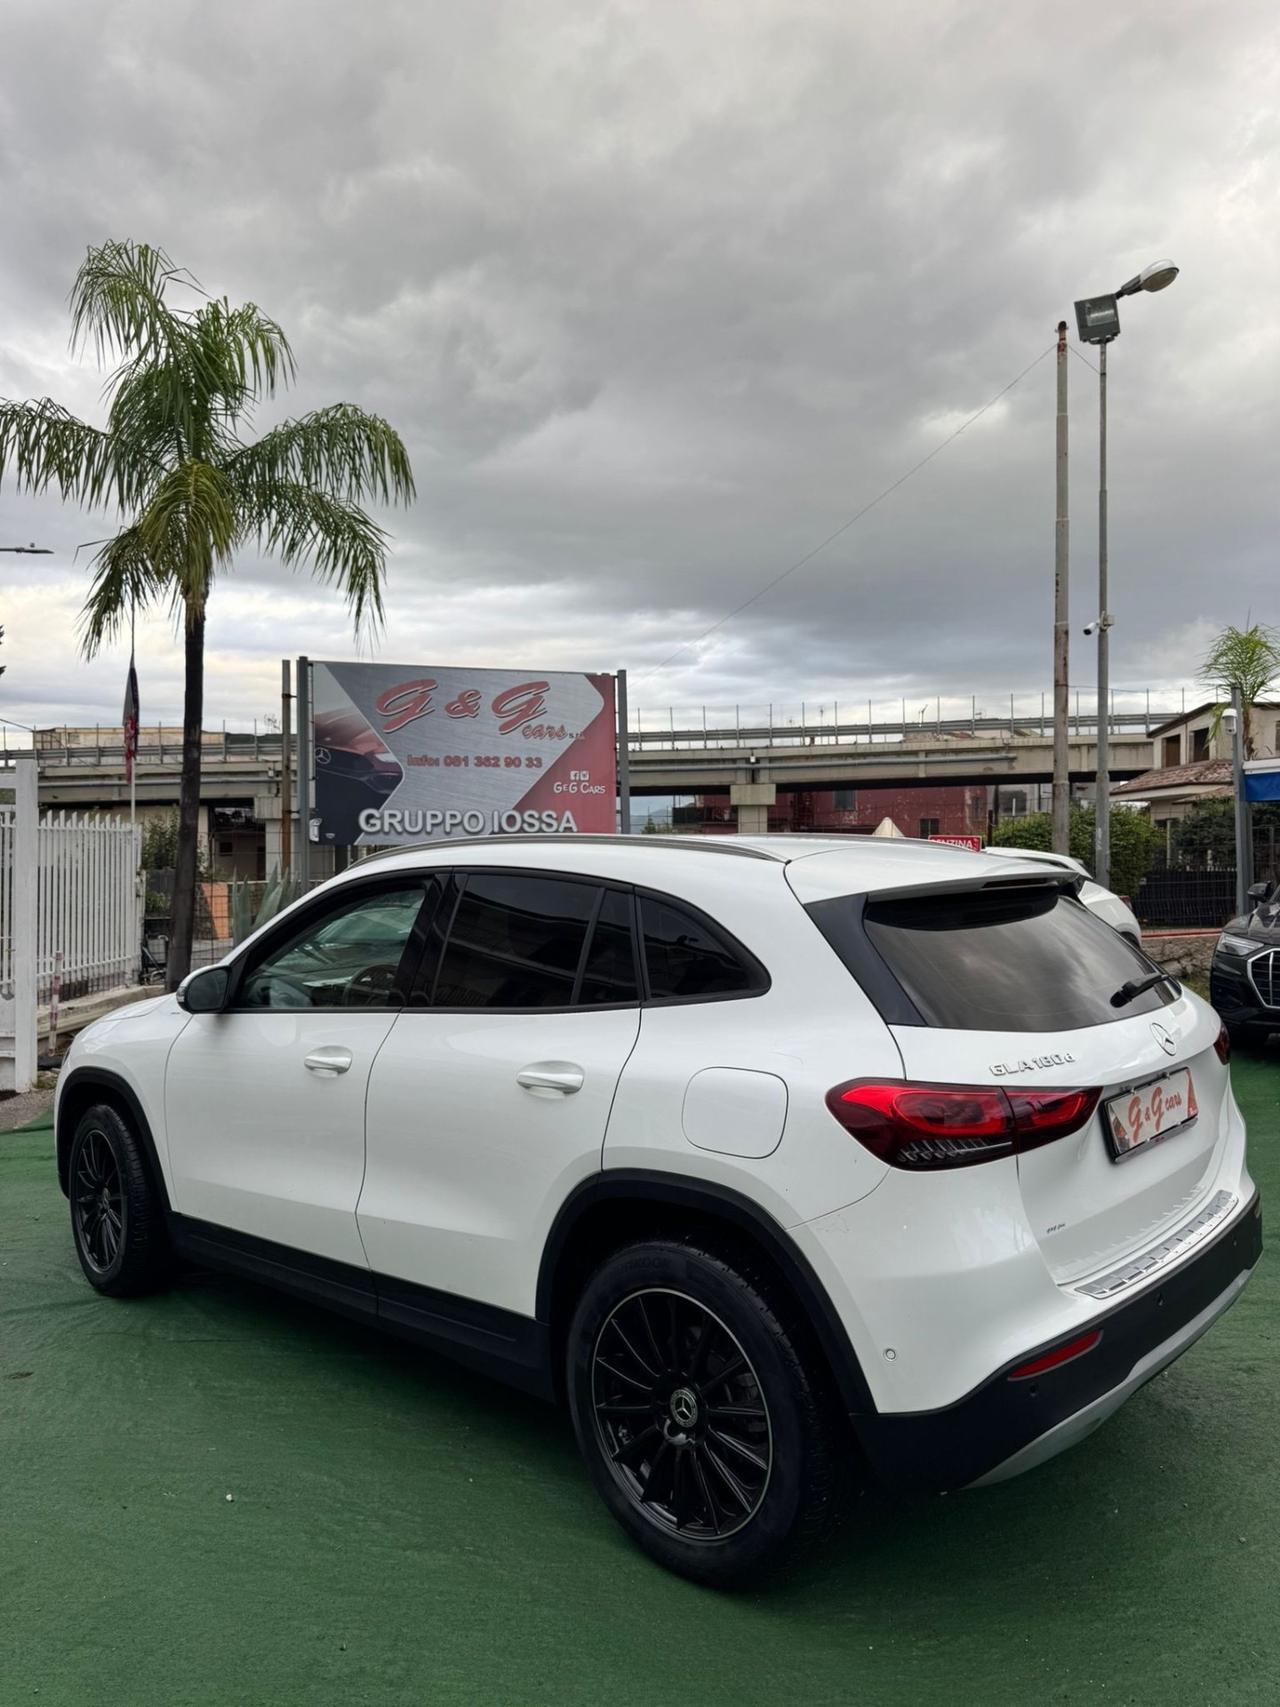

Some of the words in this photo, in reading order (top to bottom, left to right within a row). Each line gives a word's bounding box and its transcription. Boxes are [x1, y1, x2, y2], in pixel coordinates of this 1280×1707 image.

[376, 678, 438, 733] G
[444, 689, 482, 718] &
[491, 680, 551, 735] G
[443, 755, 469, 768] 081
[474, 755, 501, 768] 362
[503, 756, 522, 768] 90
[525, 756, 543, 769] 33
[358, 808, 484, 834] GRUPPO
[491, 809, 578, 834] IOSSA
[1164, 1091, 1182, 1111] cars
